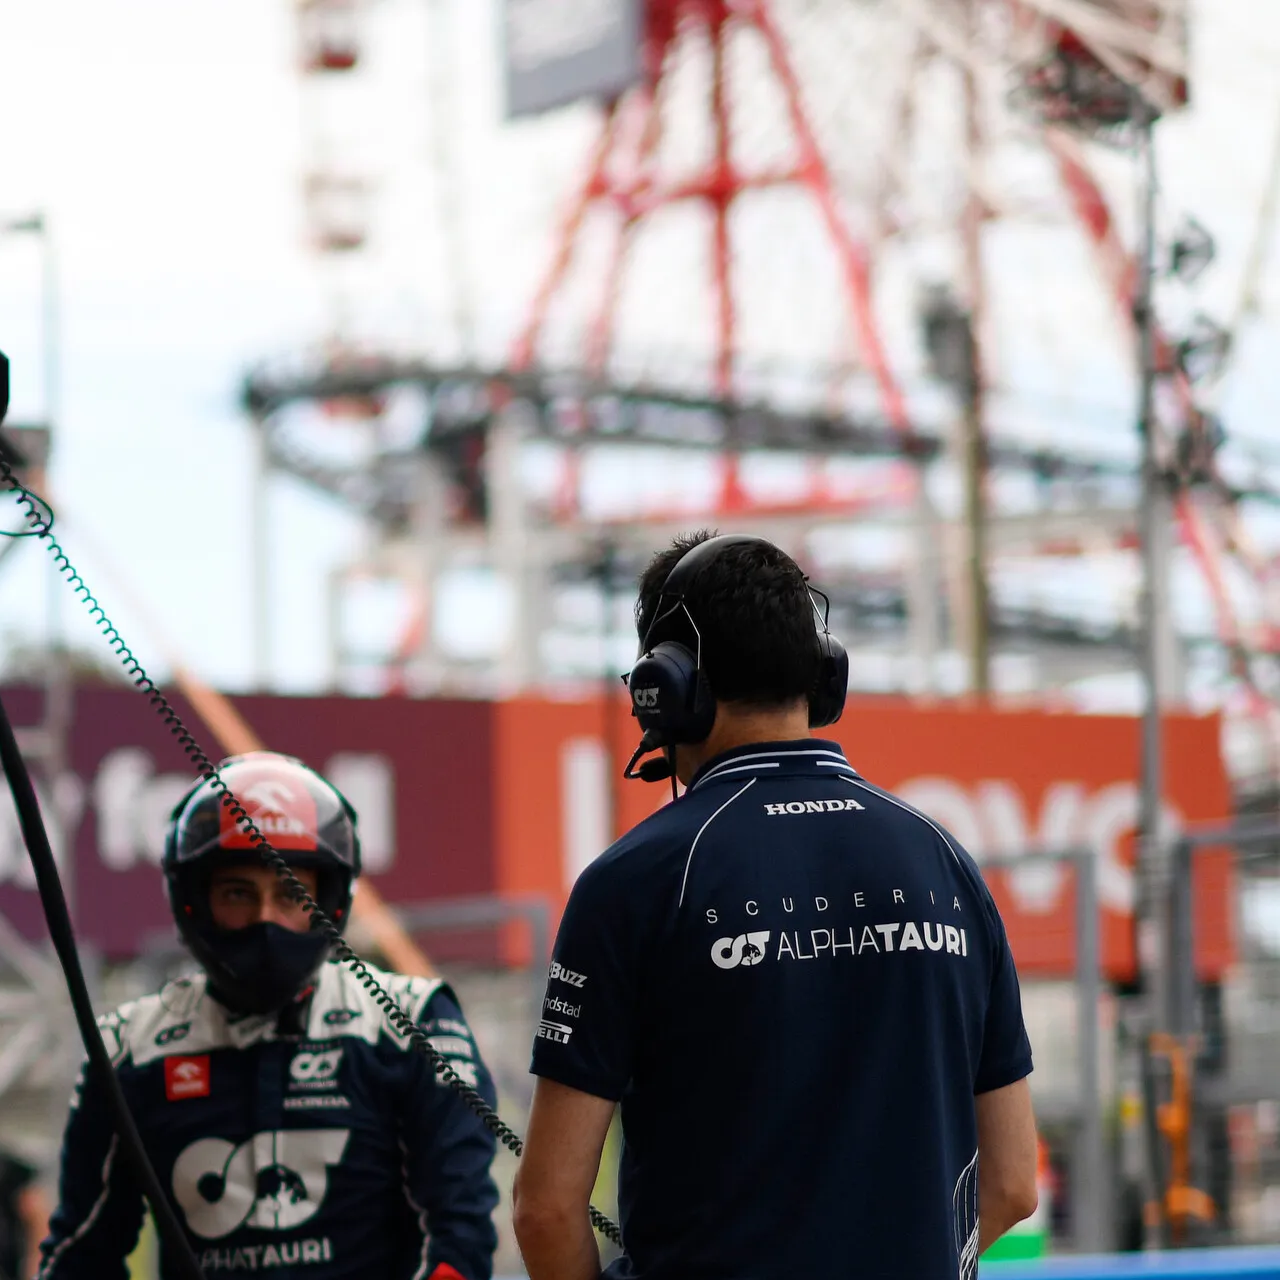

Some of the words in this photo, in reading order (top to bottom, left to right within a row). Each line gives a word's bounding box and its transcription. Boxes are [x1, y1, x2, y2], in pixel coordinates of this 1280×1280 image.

[560, 737, 1182, 914] Lovo
[764, 799, 865, 815] HONDA
[706, 888, 961, 924] SCUDERIA
[777, 921, 967, 961] ALPHATAURI
